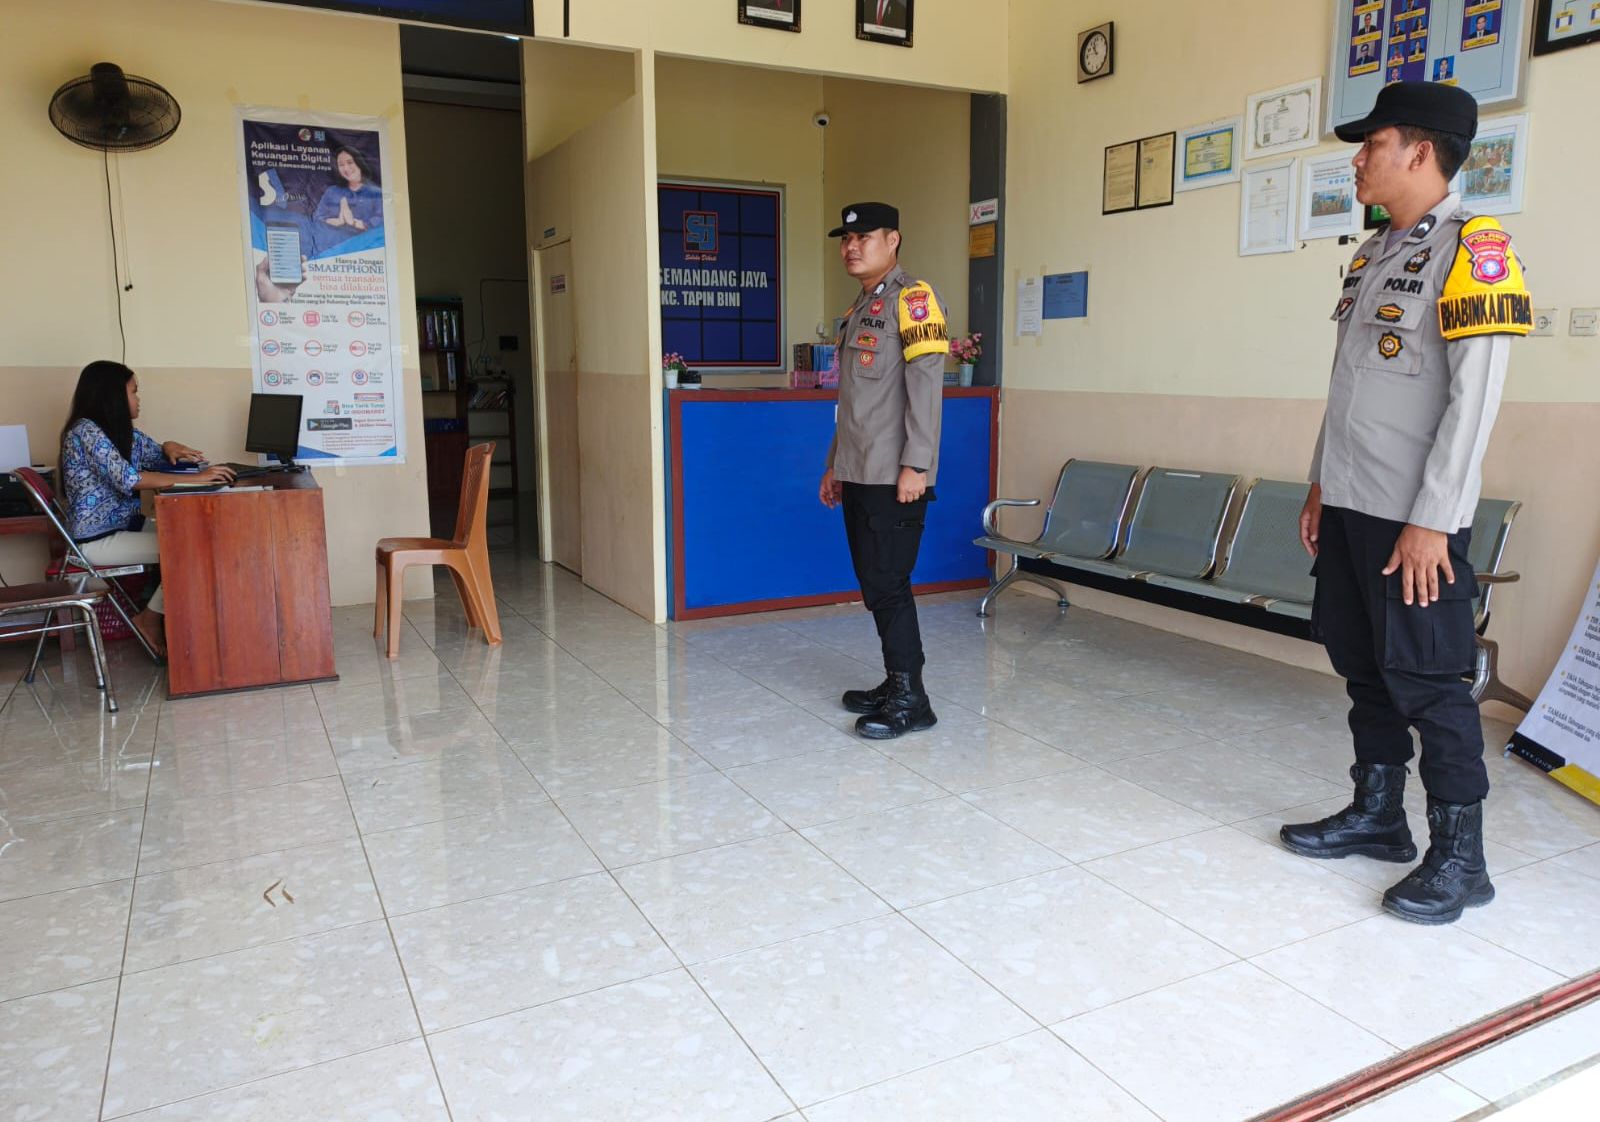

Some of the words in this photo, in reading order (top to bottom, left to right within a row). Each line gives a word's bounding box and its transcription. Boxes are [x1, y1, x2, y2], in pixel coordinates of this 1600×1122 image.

[251, 141, 289, 151] Aplikasi
[291, 144, 330, 154] Layanan
[251, 150, 299, 162] Keuangan
[301, 152, 331, 163] Digital
[279, 162, 316, 171] Semandang
[335, 257, 357, 265] Hanya
[359, 258, 384, 266] Dengan
[308, 263, 385, 274] SMARTPHONE
[739, 271, 768, 288] JAYA
[1383, 278, 1424, 294] POLRI
[661, 290, 680, 305] KC.
[681, 291, 715, 307] TAPIN
[717, 292, 741, 307] BINI
[860, 317, 885, 329] POLRI
